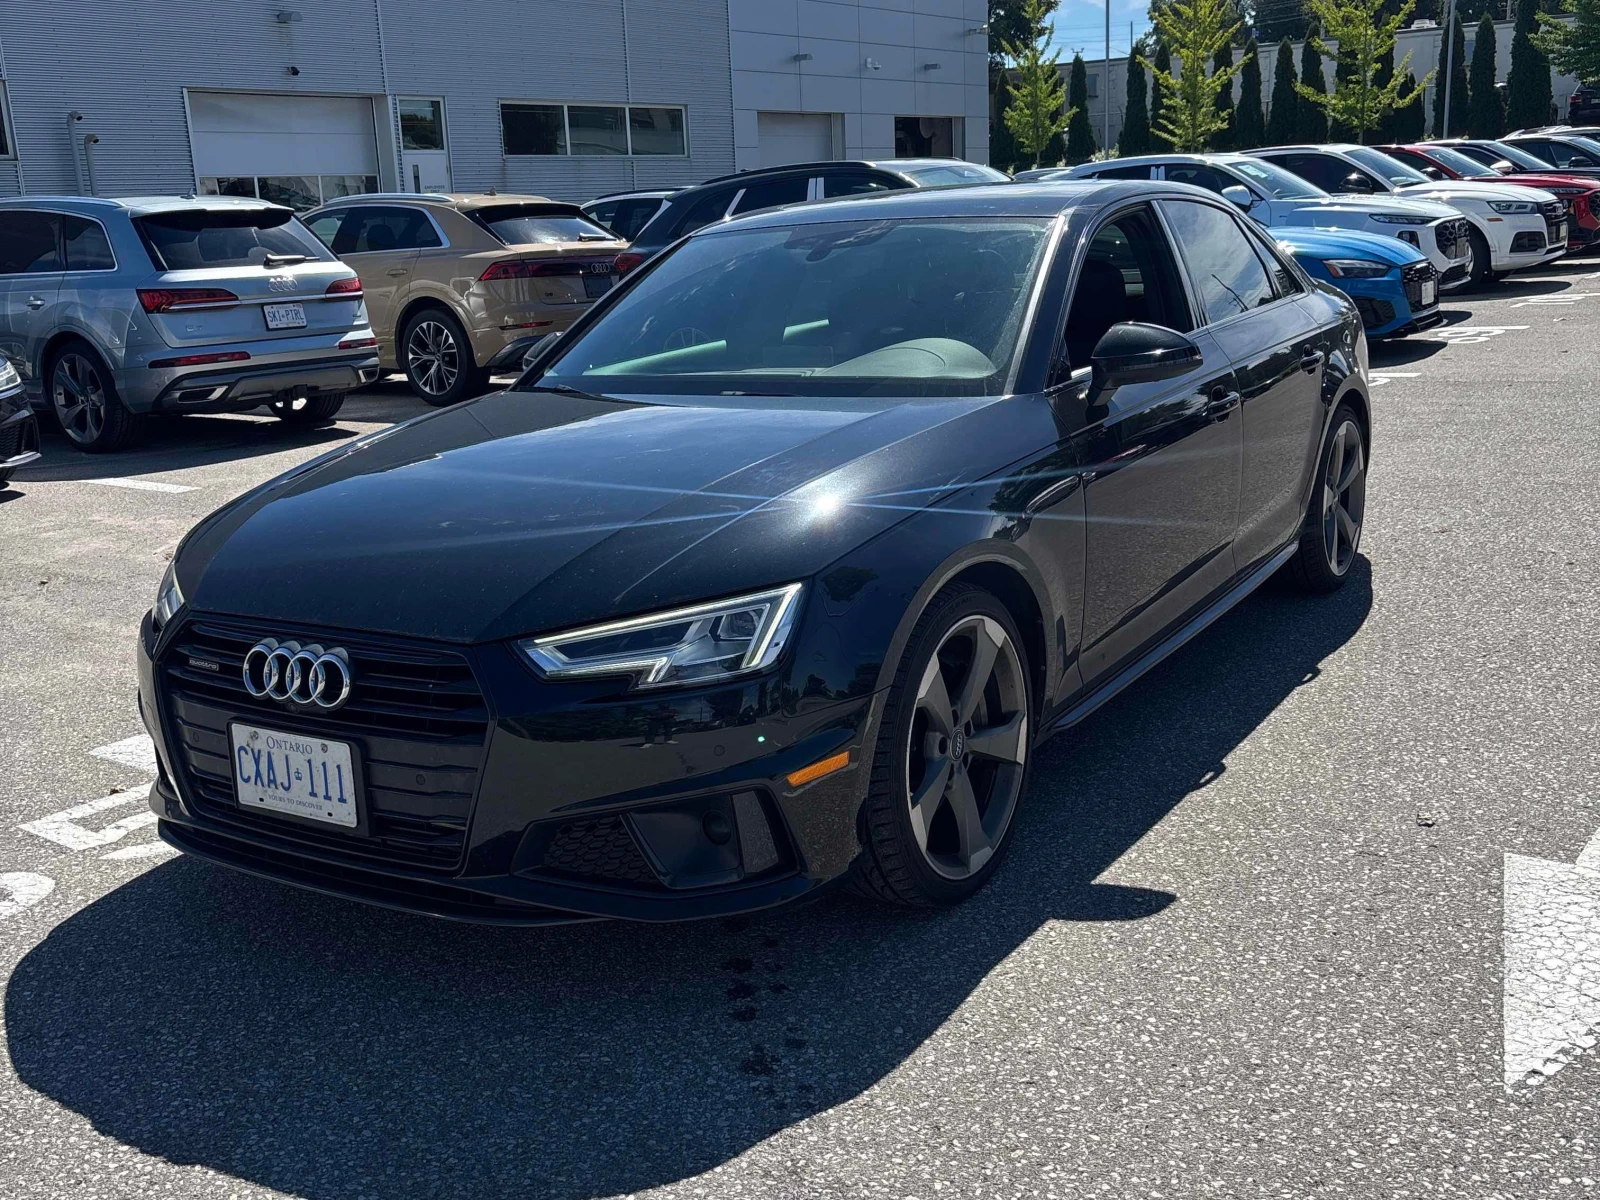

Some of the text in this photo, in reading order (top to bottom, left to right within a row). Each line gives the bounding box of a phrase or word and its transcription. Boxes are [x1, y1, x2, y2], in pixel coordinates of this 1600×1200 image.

[284, 309, 305, 321] PTRL
[266, 735, 313, 755] ONTARIO
[237, 745, 348, 804] CXAJ 111
[268, 794, 286, 803] YOURS
[295, 799, 323, 811] DISCOVER
